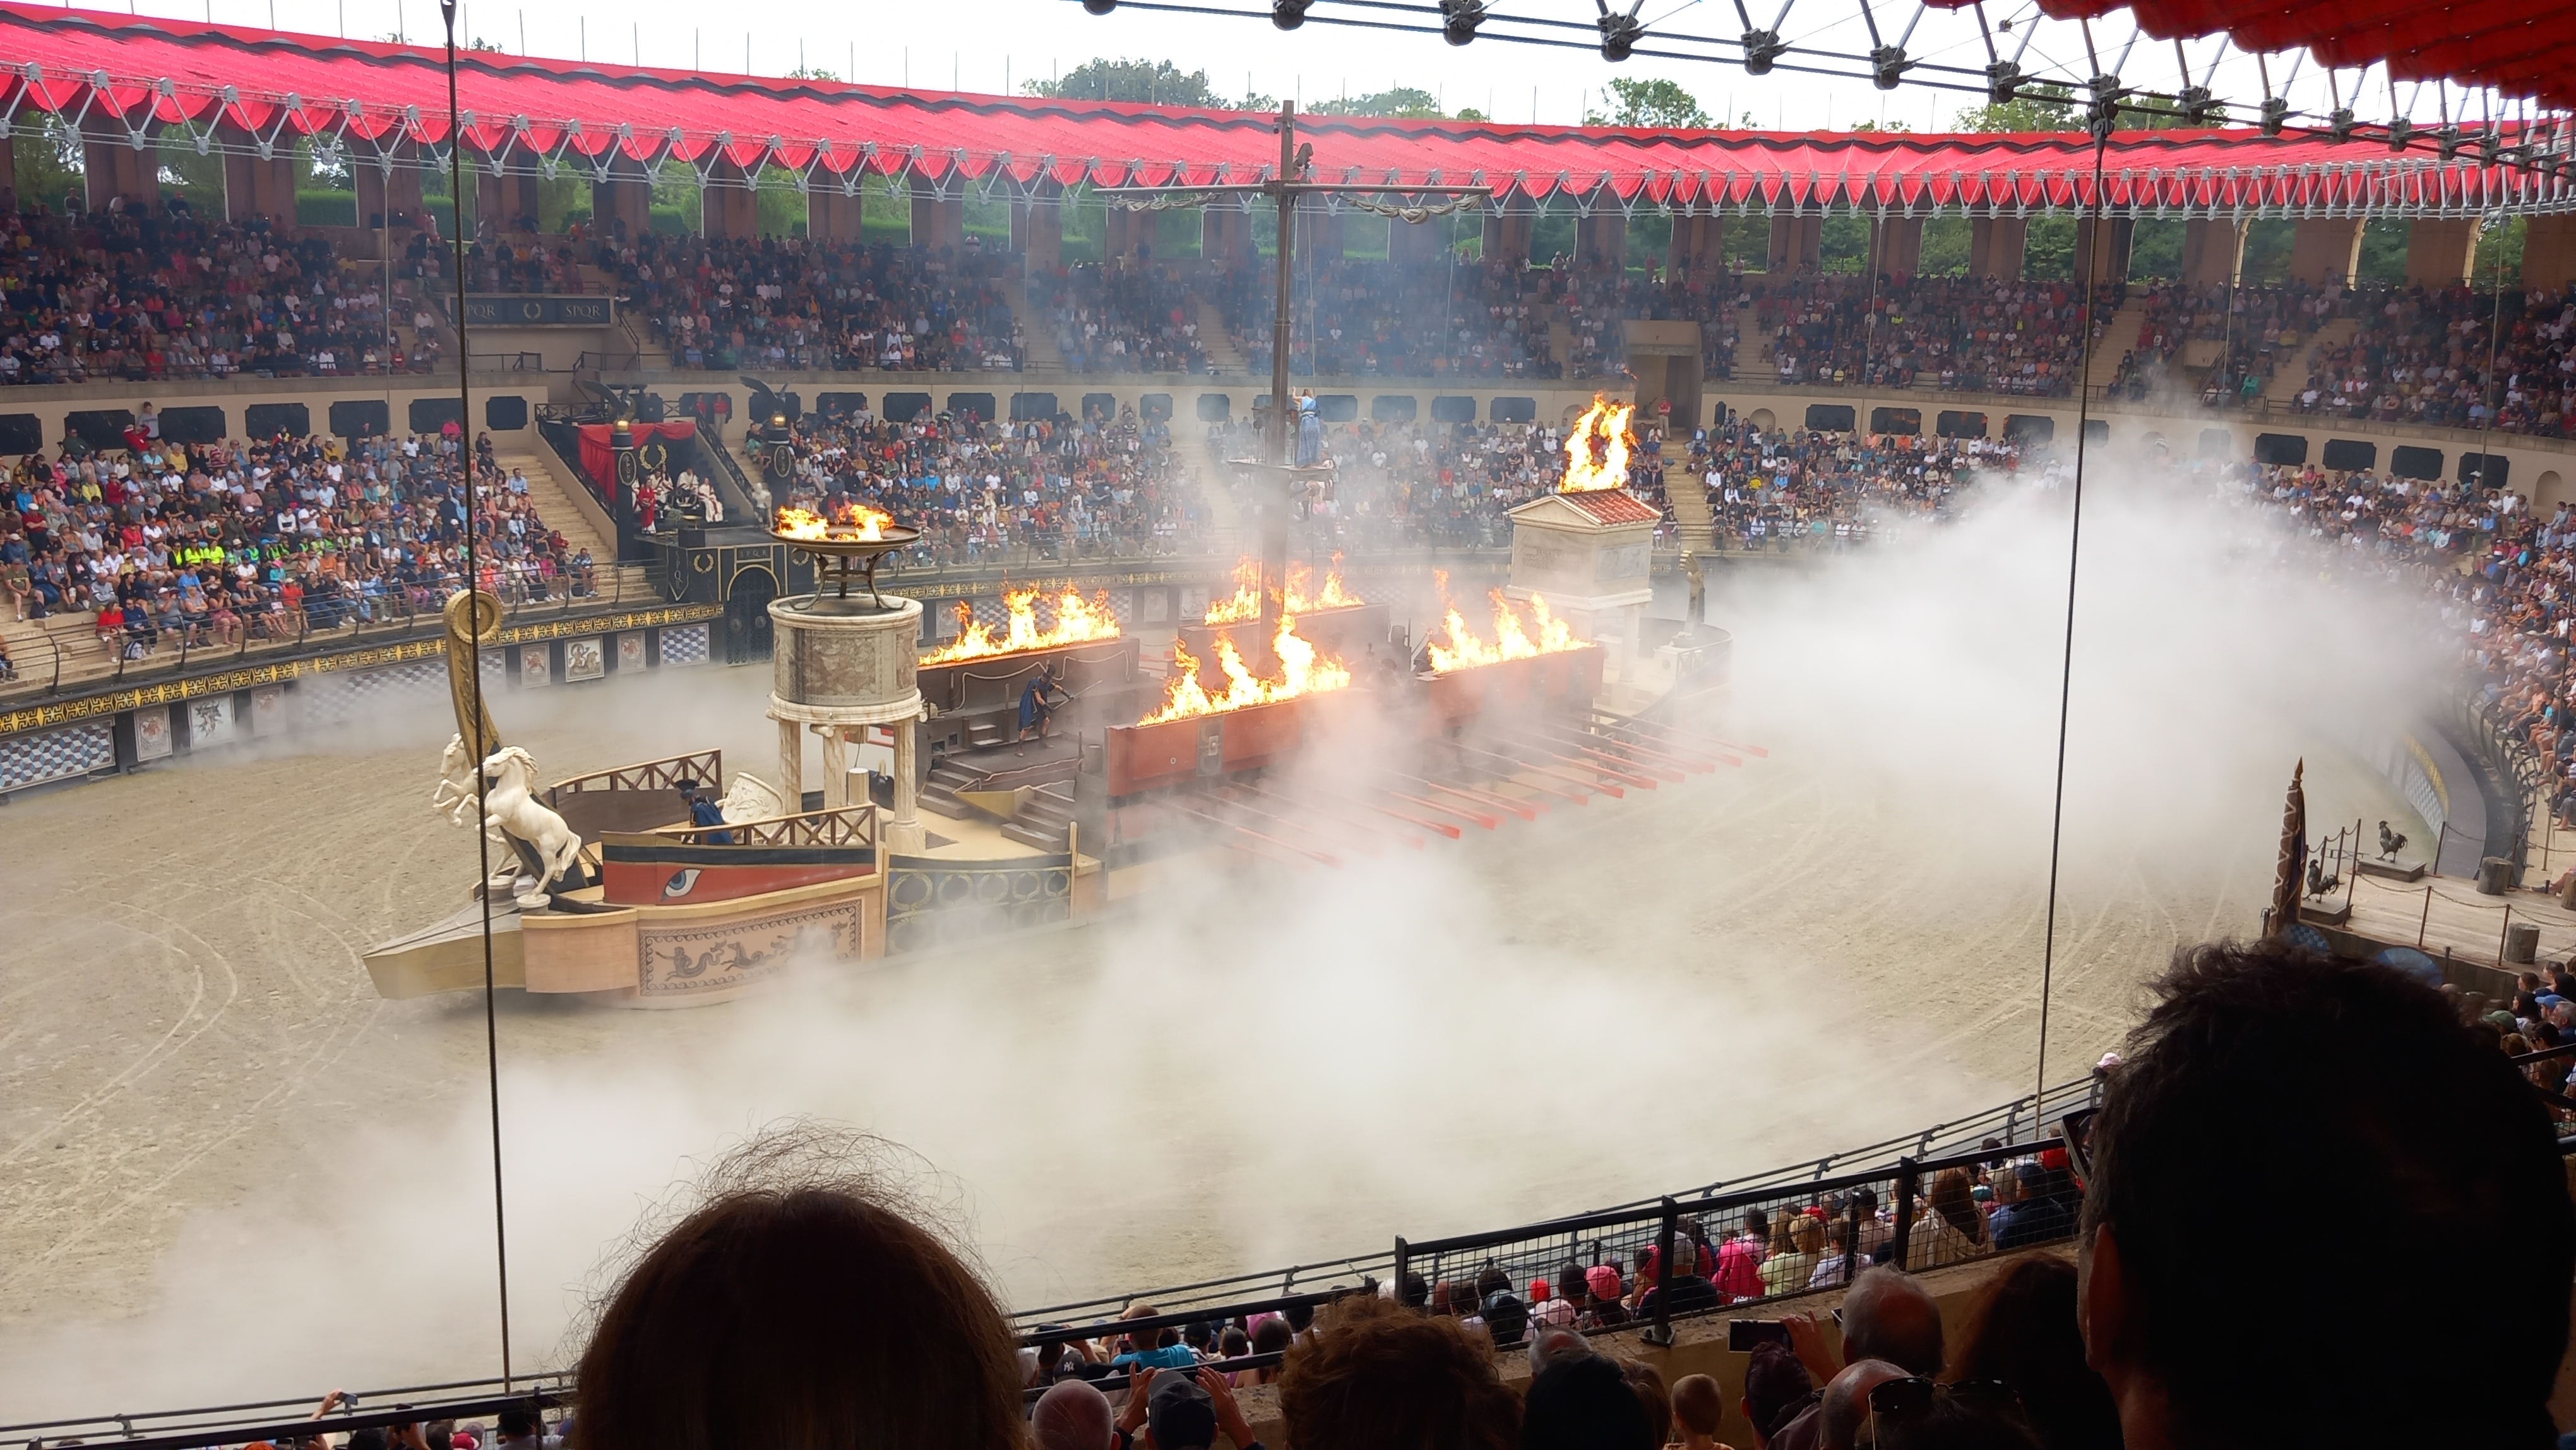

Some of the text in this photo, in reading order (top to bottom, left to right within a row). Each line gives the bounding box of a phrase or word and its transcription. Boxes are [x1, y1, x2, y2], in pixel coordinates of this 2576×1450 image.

[464, 304, 496, 320] PQR
[566, 304, 601, 320] SPQR
[740, 549, 768, 558] SPQR
[674, 550, 684, 590] SPQR
[1063, 1361, 1075, 1372] NY
